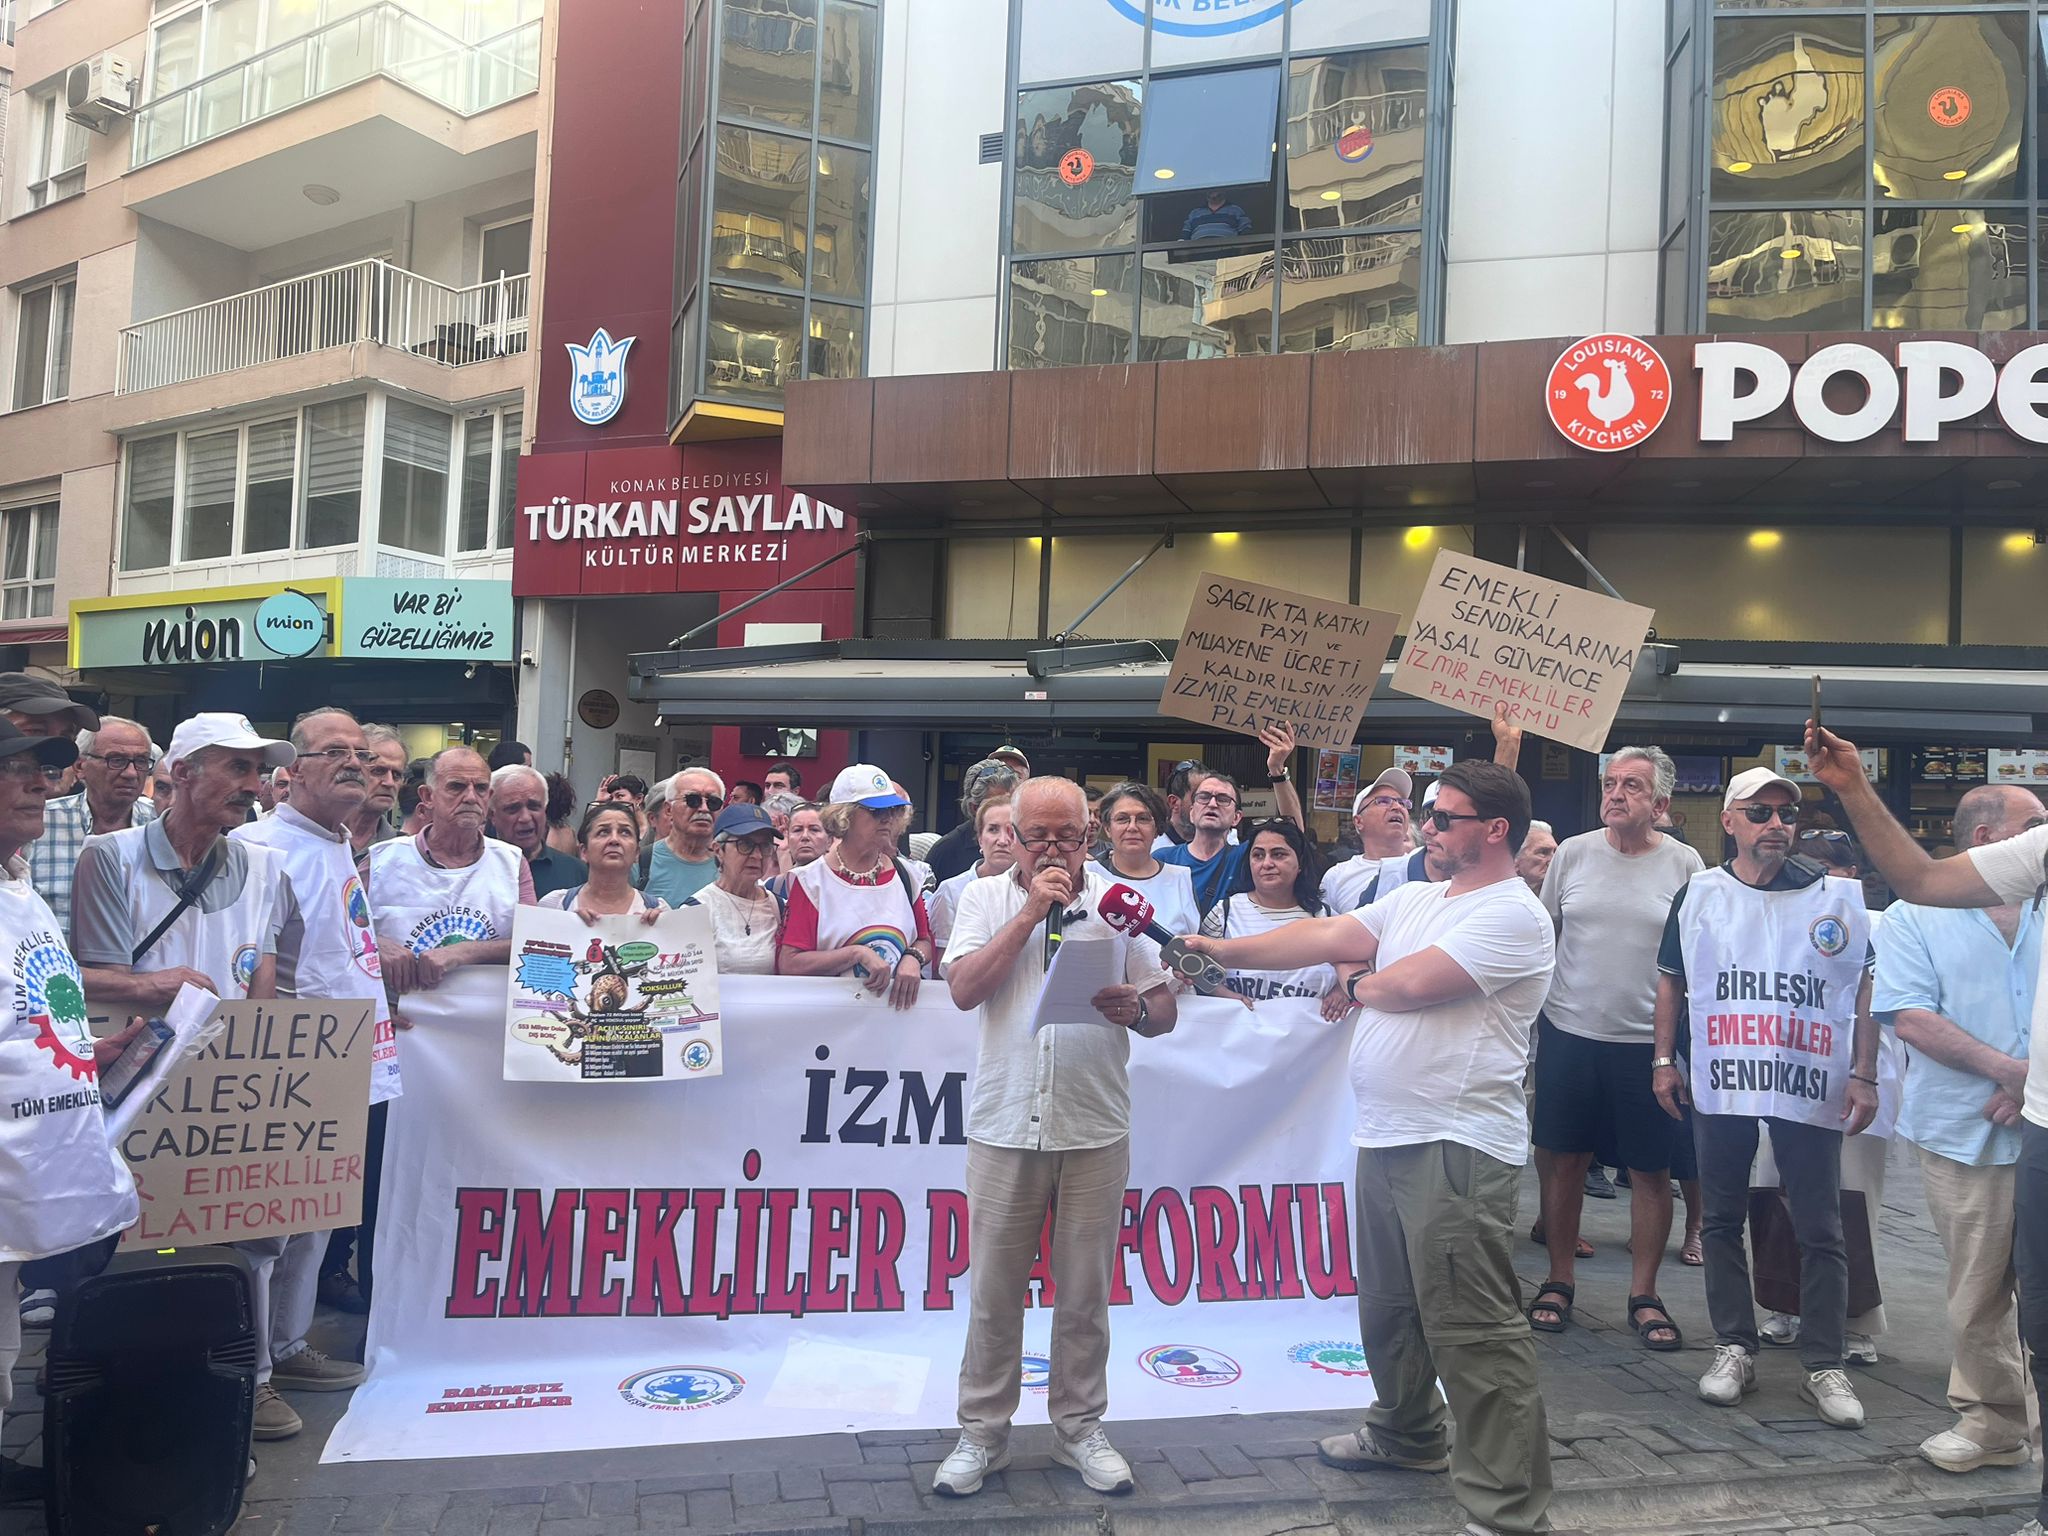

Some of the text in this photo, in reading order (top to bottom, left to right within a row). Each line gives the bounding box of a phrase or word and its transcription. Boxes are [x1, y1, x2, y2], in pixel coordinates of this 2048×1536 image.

[1564, 340, 1655, 371] LOUISIANA
[1554, 390, 1663, 399] 19 72
[1567, 419, 1648, 444] KITCHEN
[610, 469, 769, 494] KONAK BELEDİYESİ
[524, 493, 844, 541] TÜRKAN SAYLAN
[585, 539, 788, 567] KÜLTÜR MERKEZİ
[393, 591, 430, 614] VAR
[1439, 567, 1561, 619] EMEKLİ
[142, 606, 243, 663] mion
[266, 615, 314, 632] mion
[360, 621, 494, 651] GÜZELLİĞİMİZ
[1258, 623, 1308, 646] PAYI
[1313, 611, 1370, 637] KATKI
[1451, 600, 1633, 673] SENDİKALARINA
[1185, 631, 1362, 679] MUAYENE ÜCRETİ
[1413, 620, 1603, 693] YASAL GÜVENCE
[1172, 673, 1354, 723] İZMİR EMEKLİLER
[1430, 681, 1560, 730] PLATFORMU
[1476, 669, 1594, 719] EMEKLİLER
[410, 905, 500, 940] EMEKLİLER SENDİ
[12, 930, 55, 1025] TÜM EMEKLİLE
[640, 982, 683, 992] YOKSULLUK
[1716, 963, 1826, 1010] BİRLEŞİK
[1707, 1011, 1833, 1056] EMEKLİLER
[800, 1044, 966, 1147] İZM
[1710, 1053, 1828, 1101] SENDİKASI
[11, 1088, 100, 1119] TÜM EMEKLİLE
[122, 1120, 338, 1162] CADELEYE
[183, 1154, 362, 1195] EMEKLİLER
[445, 1149, 905, 1320] EMEKLİLER
[425, 1396, 573, 1414] EMEKLİLER
[442, 1383, 564, 1399] BAĞIMSIZ
[648, 1402, 713, 1412] EMEKLİLER
